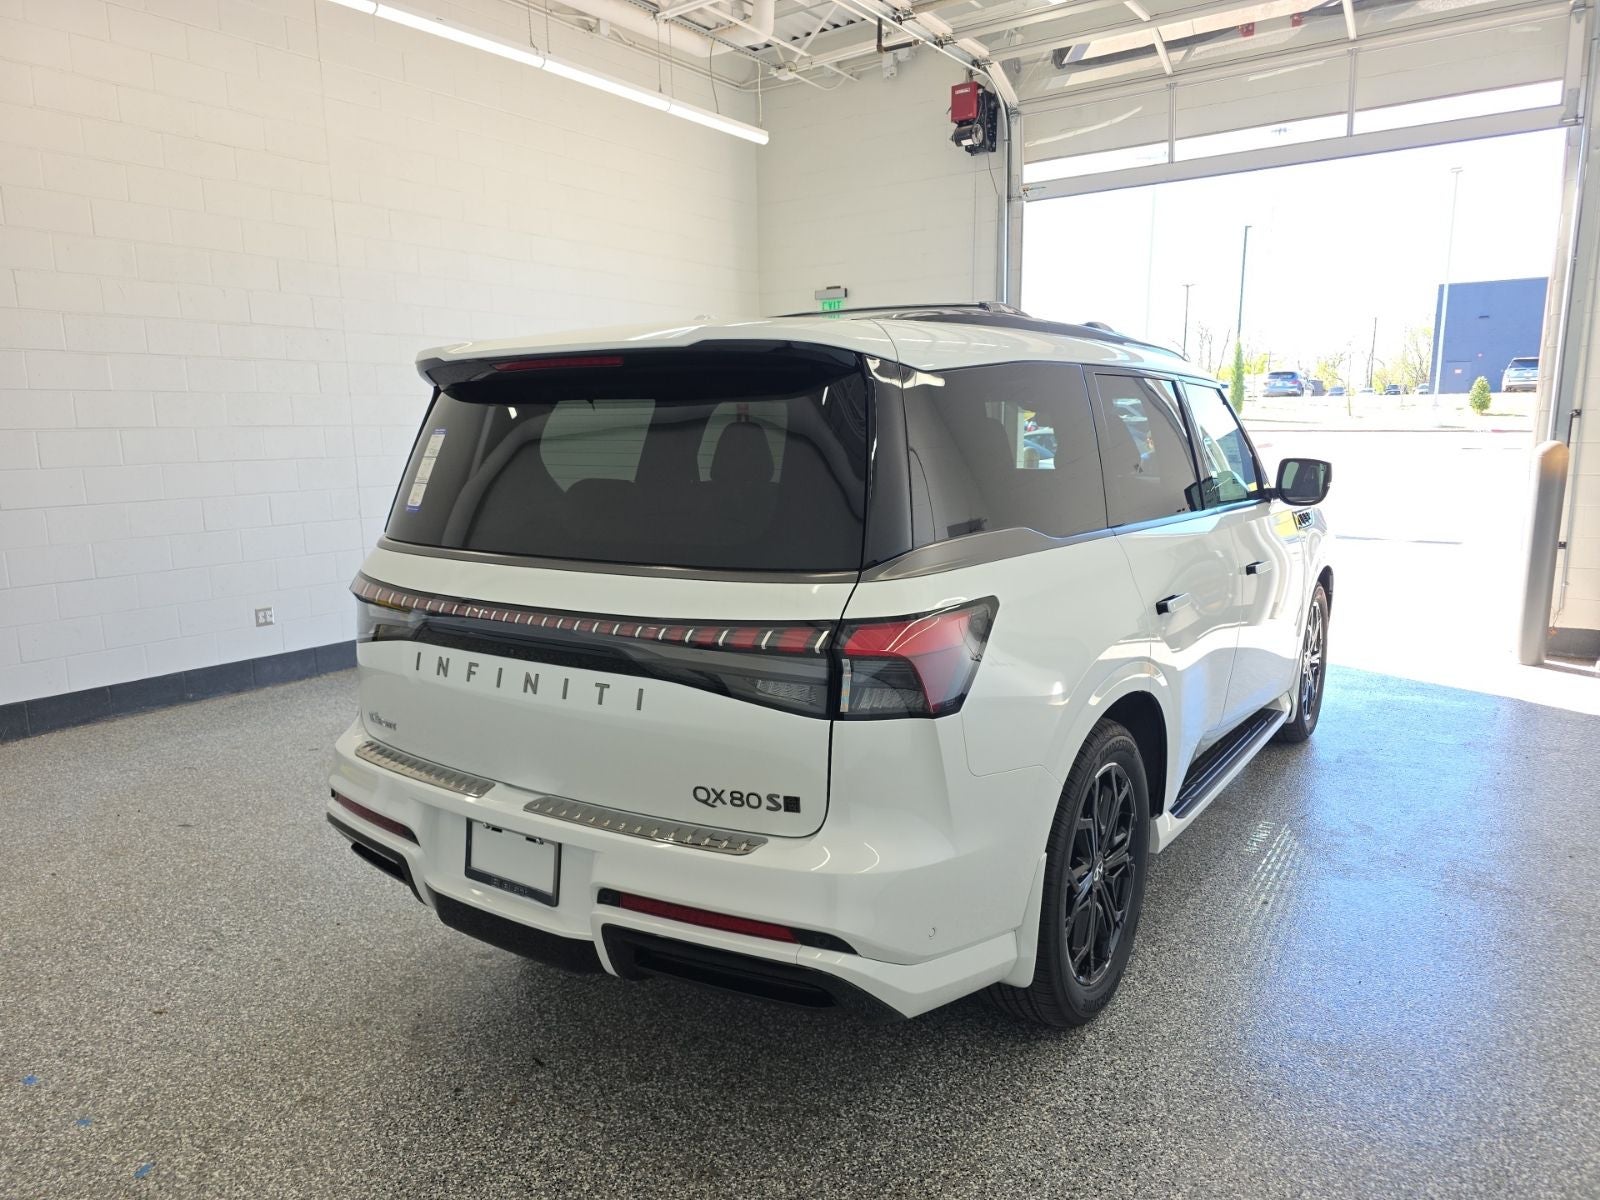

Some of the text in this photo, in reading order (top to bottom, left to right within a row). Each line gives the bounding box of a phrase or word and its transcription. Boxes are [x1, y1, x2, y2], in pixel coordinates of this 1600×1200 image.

[821, 300, 842, 311] EXIT
[415, 651, 645, 711] INFINITI
[692, 785, 763, 809] QX80
